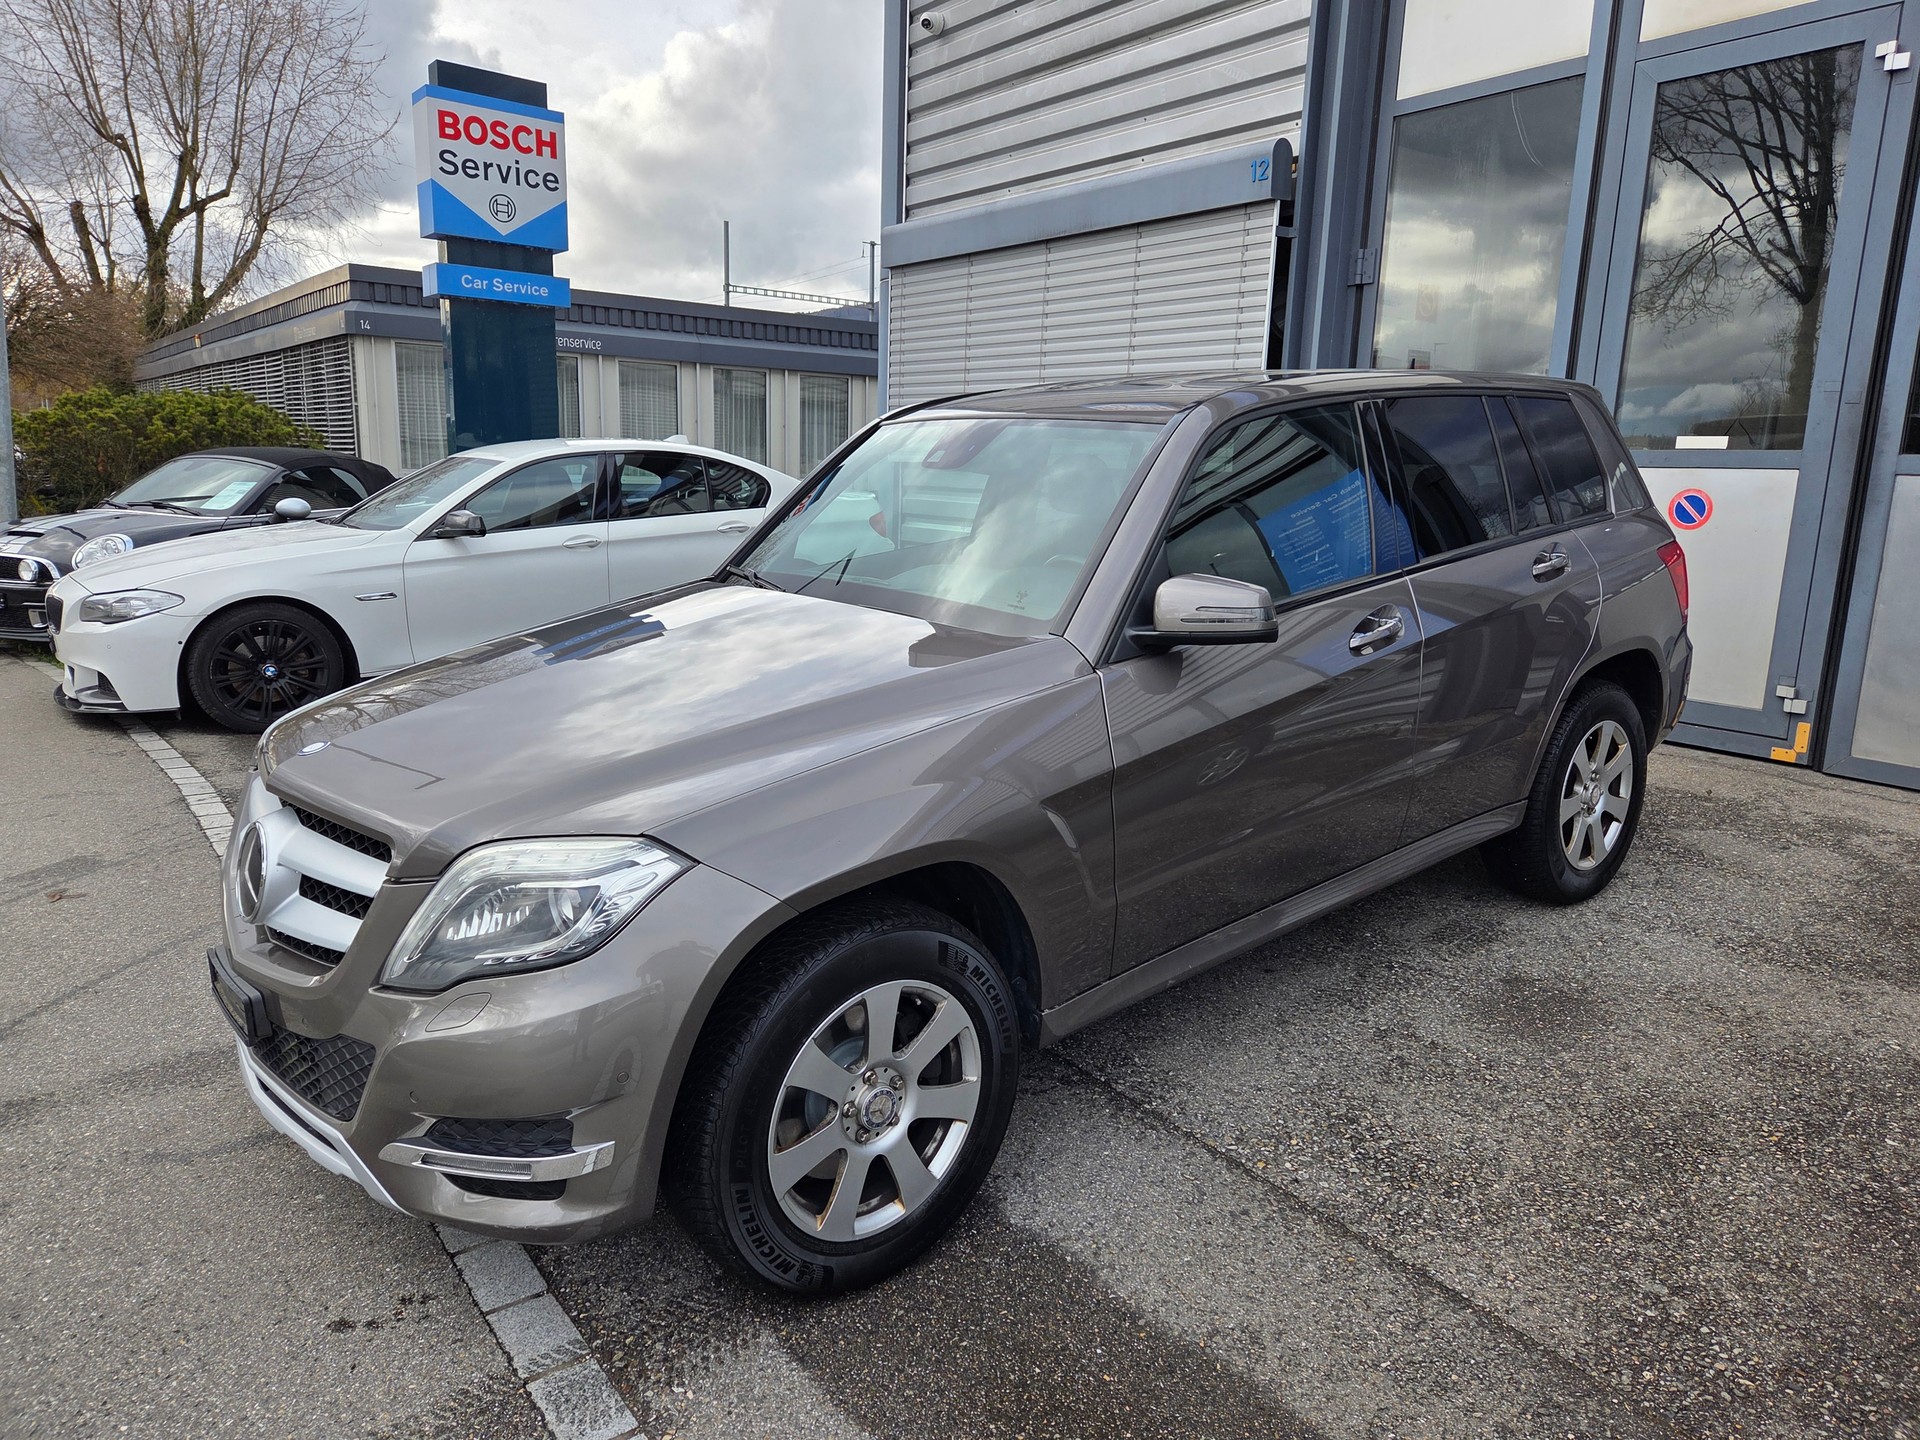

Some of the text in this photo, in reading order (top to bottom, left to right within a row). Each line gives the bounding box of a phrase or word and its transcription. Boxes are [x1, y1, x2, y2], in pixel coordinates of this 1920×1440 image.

[437, 109, 558, 160] BOSCH
[438, 149, 560, 192] Service
[1250, 157, 1270, 183] 12
[461, 274, 549, 297] Car Service
[359, 319, 371, 331] 14
[968, 962, 1014, 1052] MICHELIN
[734, 1187, 797, 1277] MICHELIN
